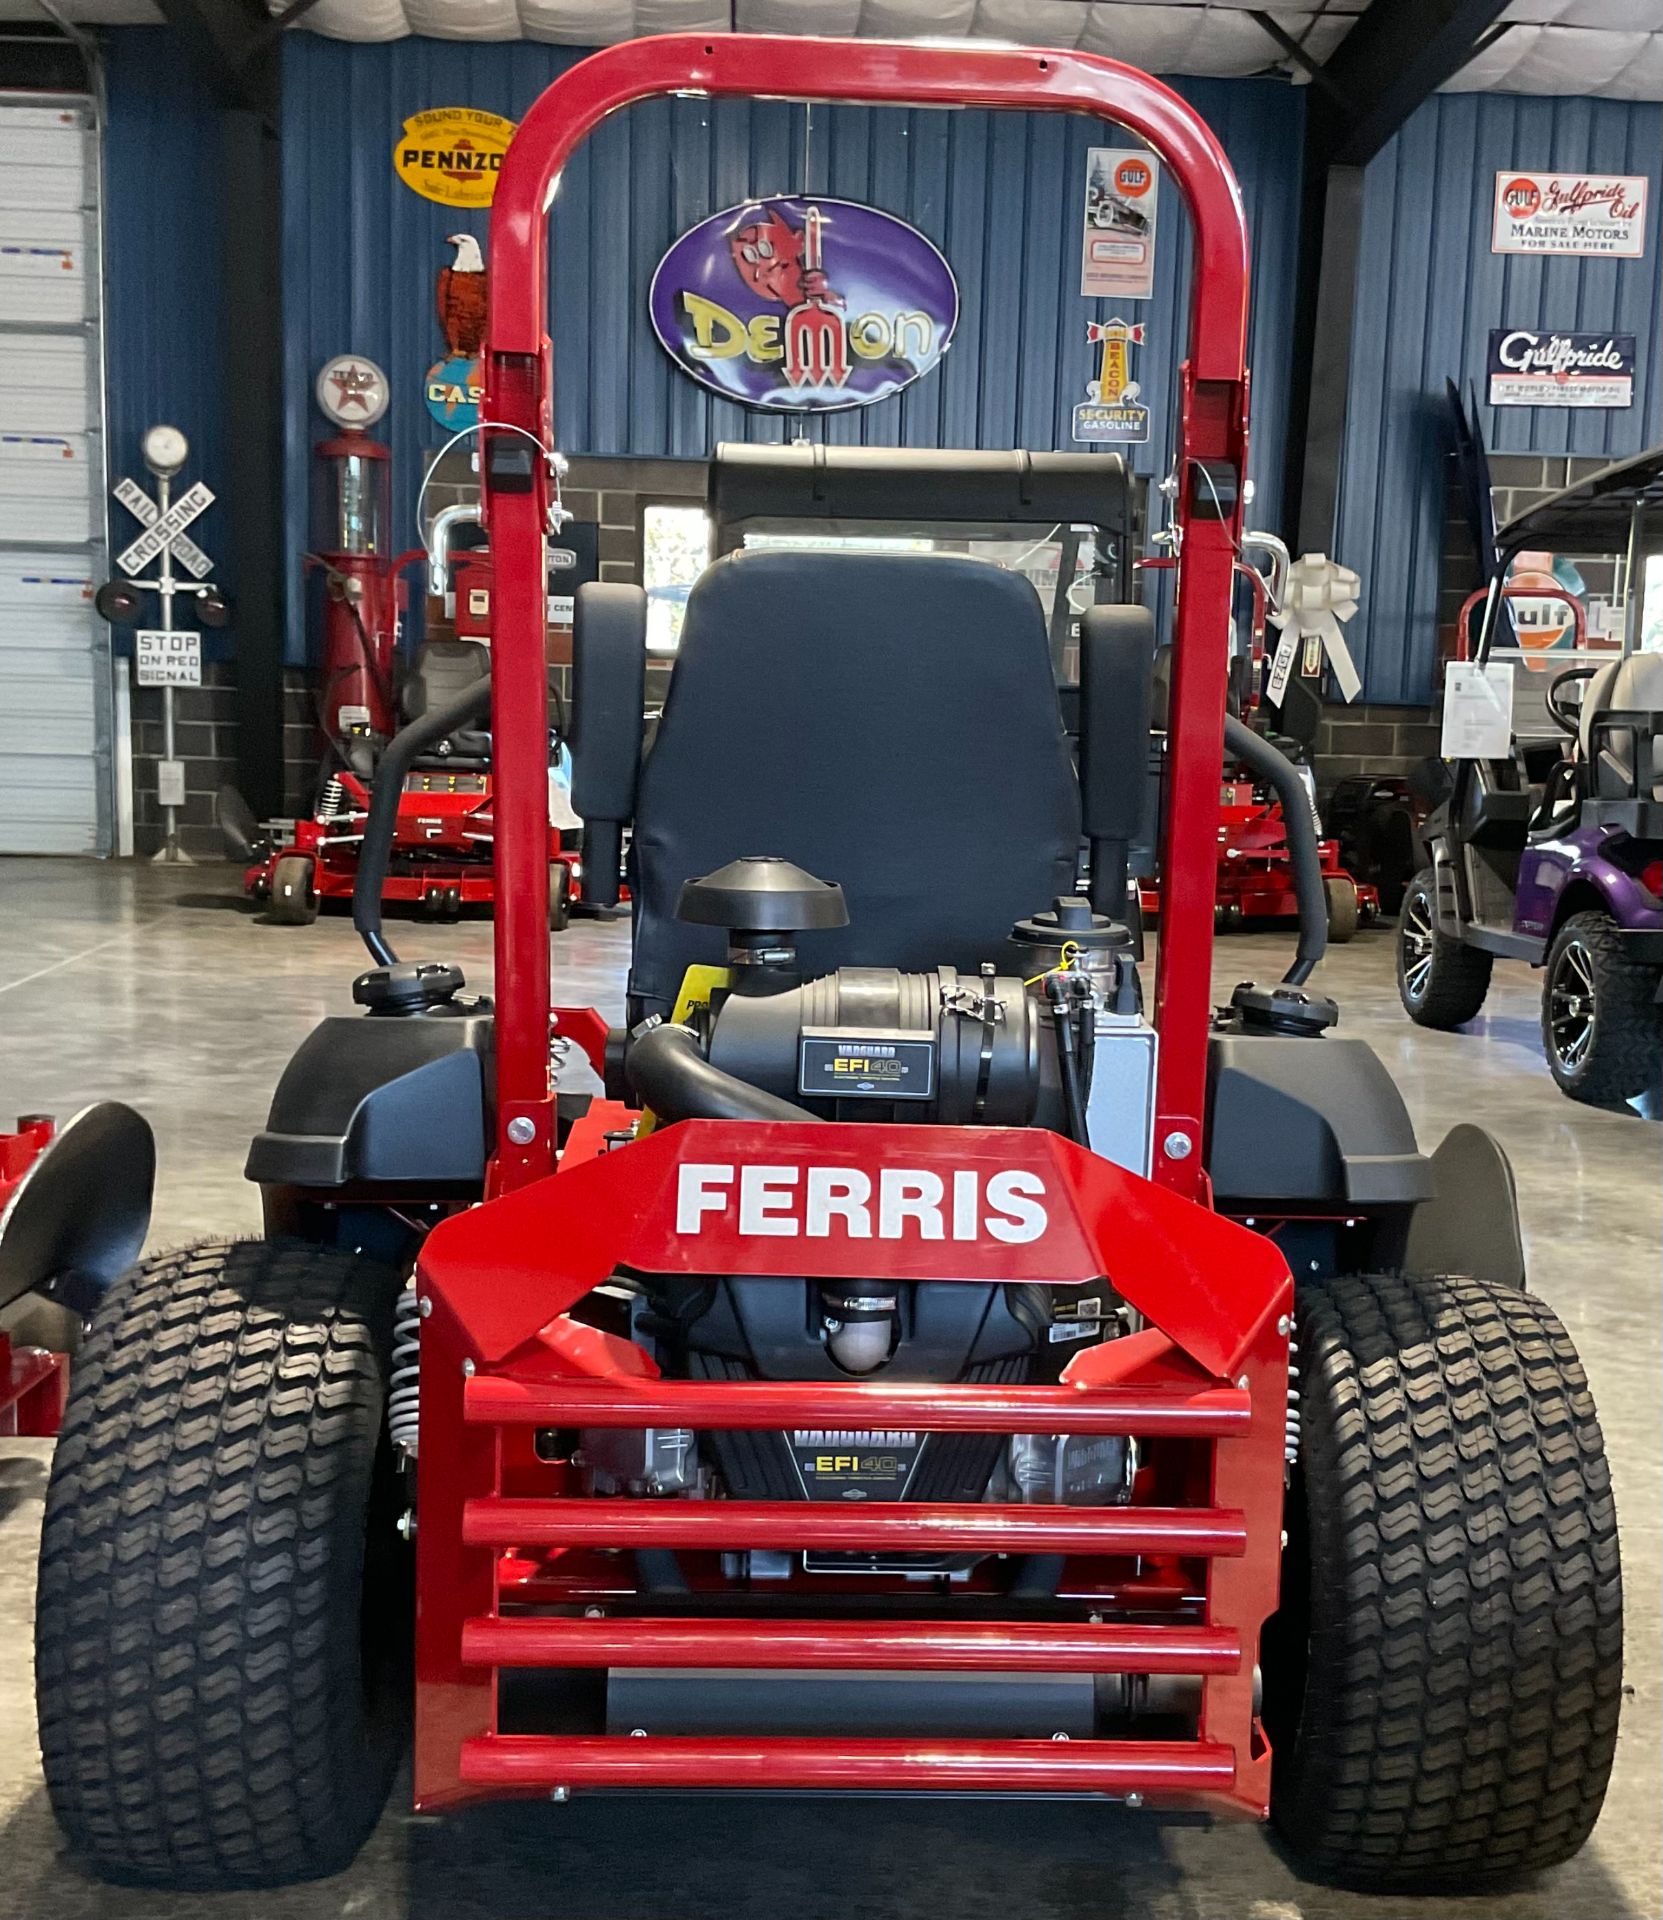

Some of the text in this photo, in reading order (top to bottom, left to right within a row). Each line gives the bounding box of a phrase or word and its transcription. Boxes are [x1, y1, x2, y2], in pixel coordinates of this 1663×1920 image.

[1120, 169, 1146, 184] GULF
[1505, 180, 1626, 213] GULF Gulfpride
[1609, 199, 1640, 219] Oil
[1511, 223, 1629, 240] MARINE MOTORS
[1521, 239, 1546, 248] FOR
[1550, 240, 1578, 249] SALE
[1500, 331, 1624, 373] Gulfpride
[1108, 342, 1120, 397] BEACON
[1079, 409, 1146, 422] SECURITY
[1083, 420, 1141, 431] GASOLINE
[122, 490, 207, 571] CROSSING
[1517, 604, 1570, 626] ulf
[140, 635, 198, 651] STOP
[140, 655, 199, 667] ON RED
[140, 670, 199, 682] SIGNAL
[838, 1044, 896, 1059] VANGUARD
[676, 1163, 1048, 1244] FERRIS
